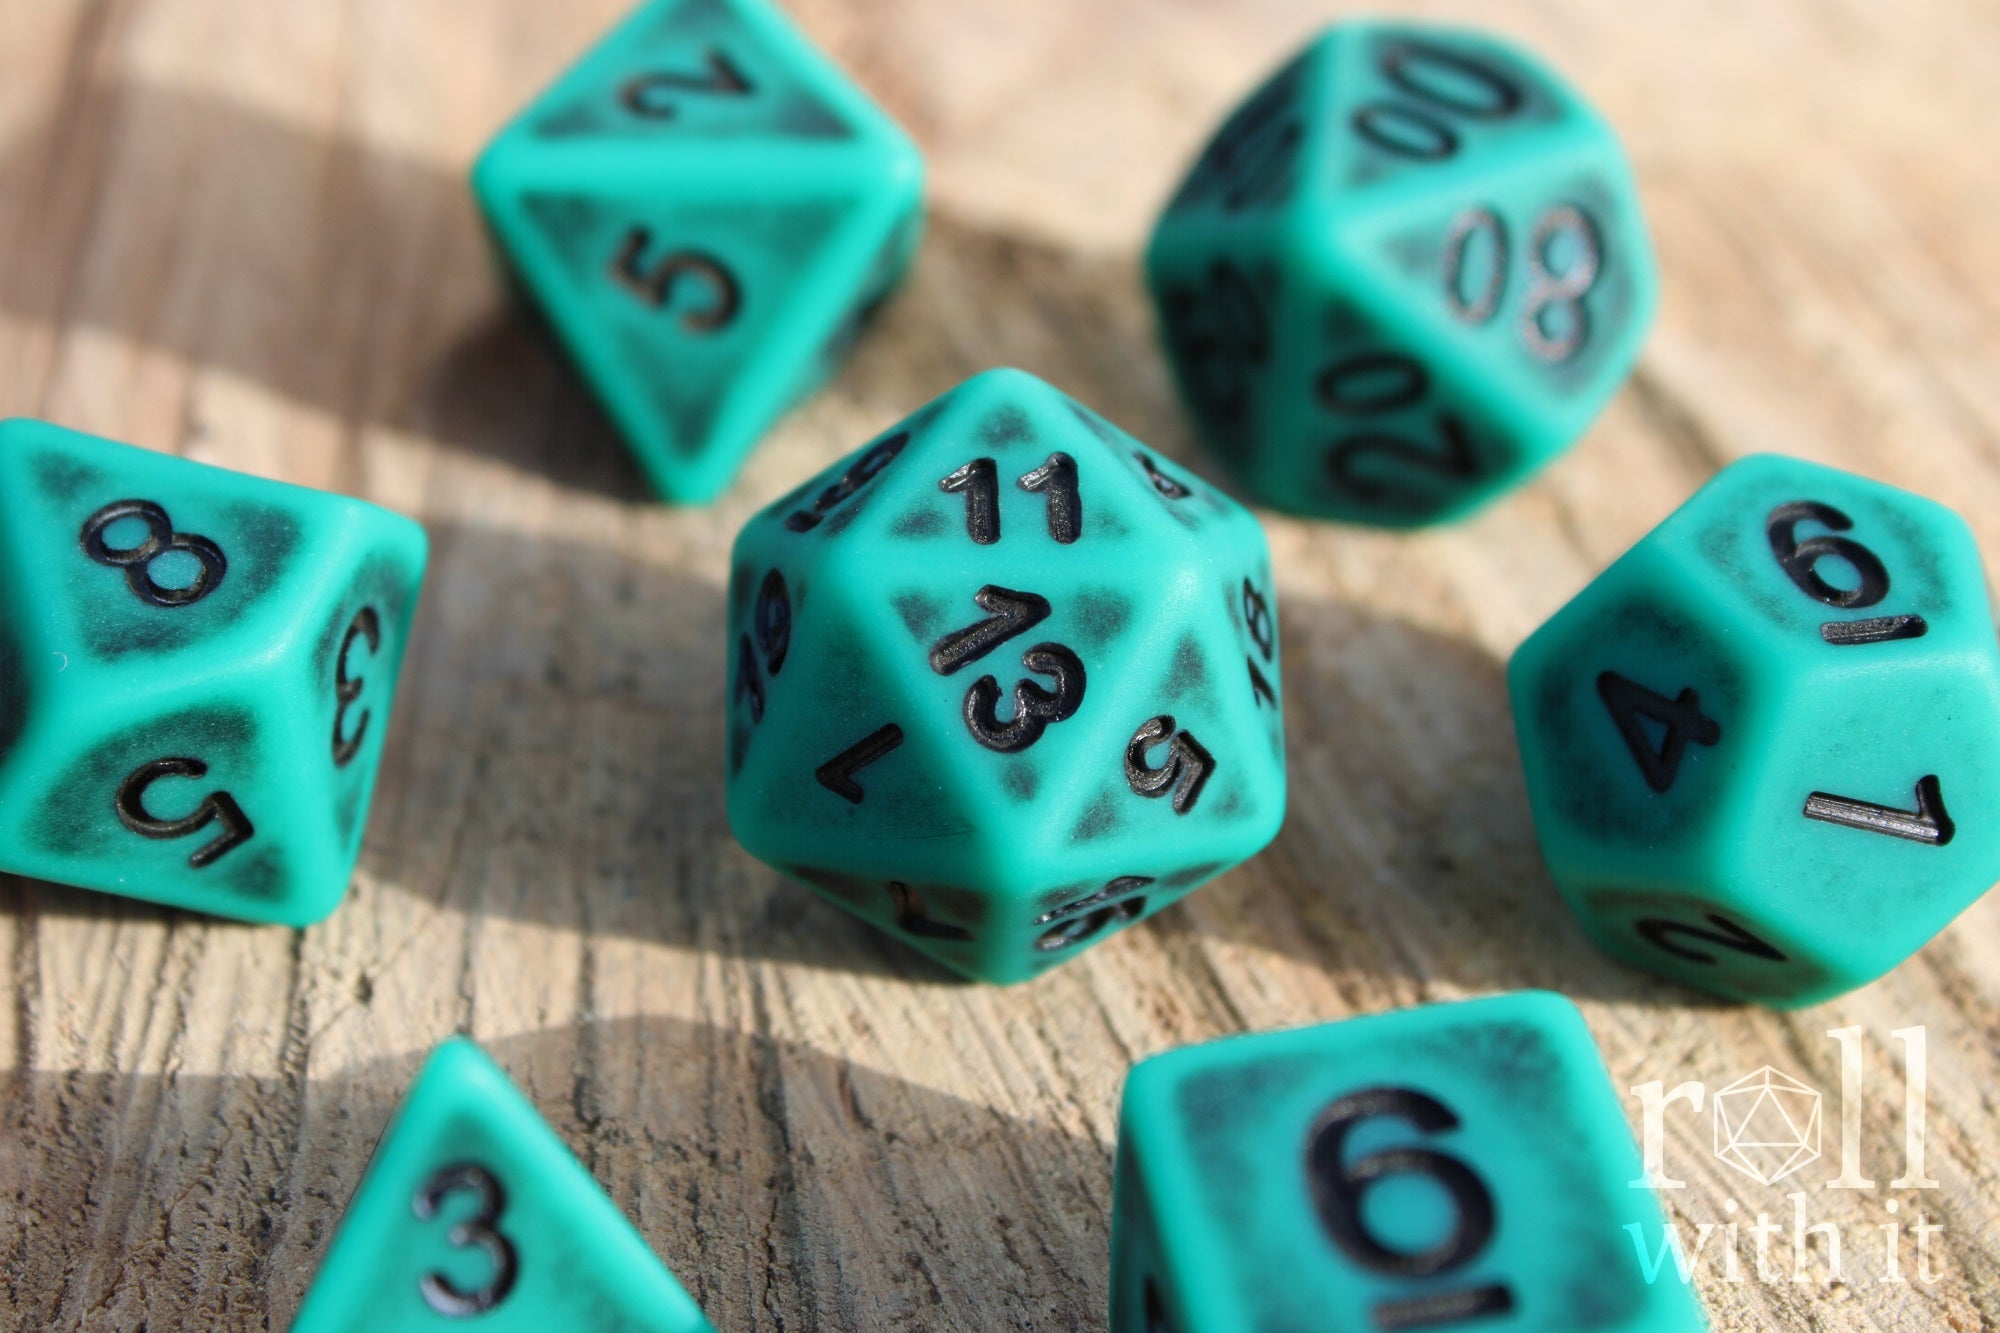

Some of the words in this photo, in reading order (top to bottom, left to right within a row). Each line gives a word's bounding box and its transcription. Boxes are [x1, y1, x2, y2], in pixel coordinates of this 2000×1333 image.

[615, 46, 756, 122] 2
[1351, 37, 1522, 164] 00
[607, 224, 745, 338] 5
[1442, 206, 1605, 363] 80
[80, 499, 227, 607] 8
[938, 451, 1082, 544] 11
[331, 606, 380, 768] 3
[930, 584, 1087, 753] 13
[1124, 714, 1216, 815] 5
[1596, 670, 1721, 793] 4
[115, 758, 254, 868] 5
[1636, 913, 1788, 966] 2
[411, 1162, 518, 1317] 3
